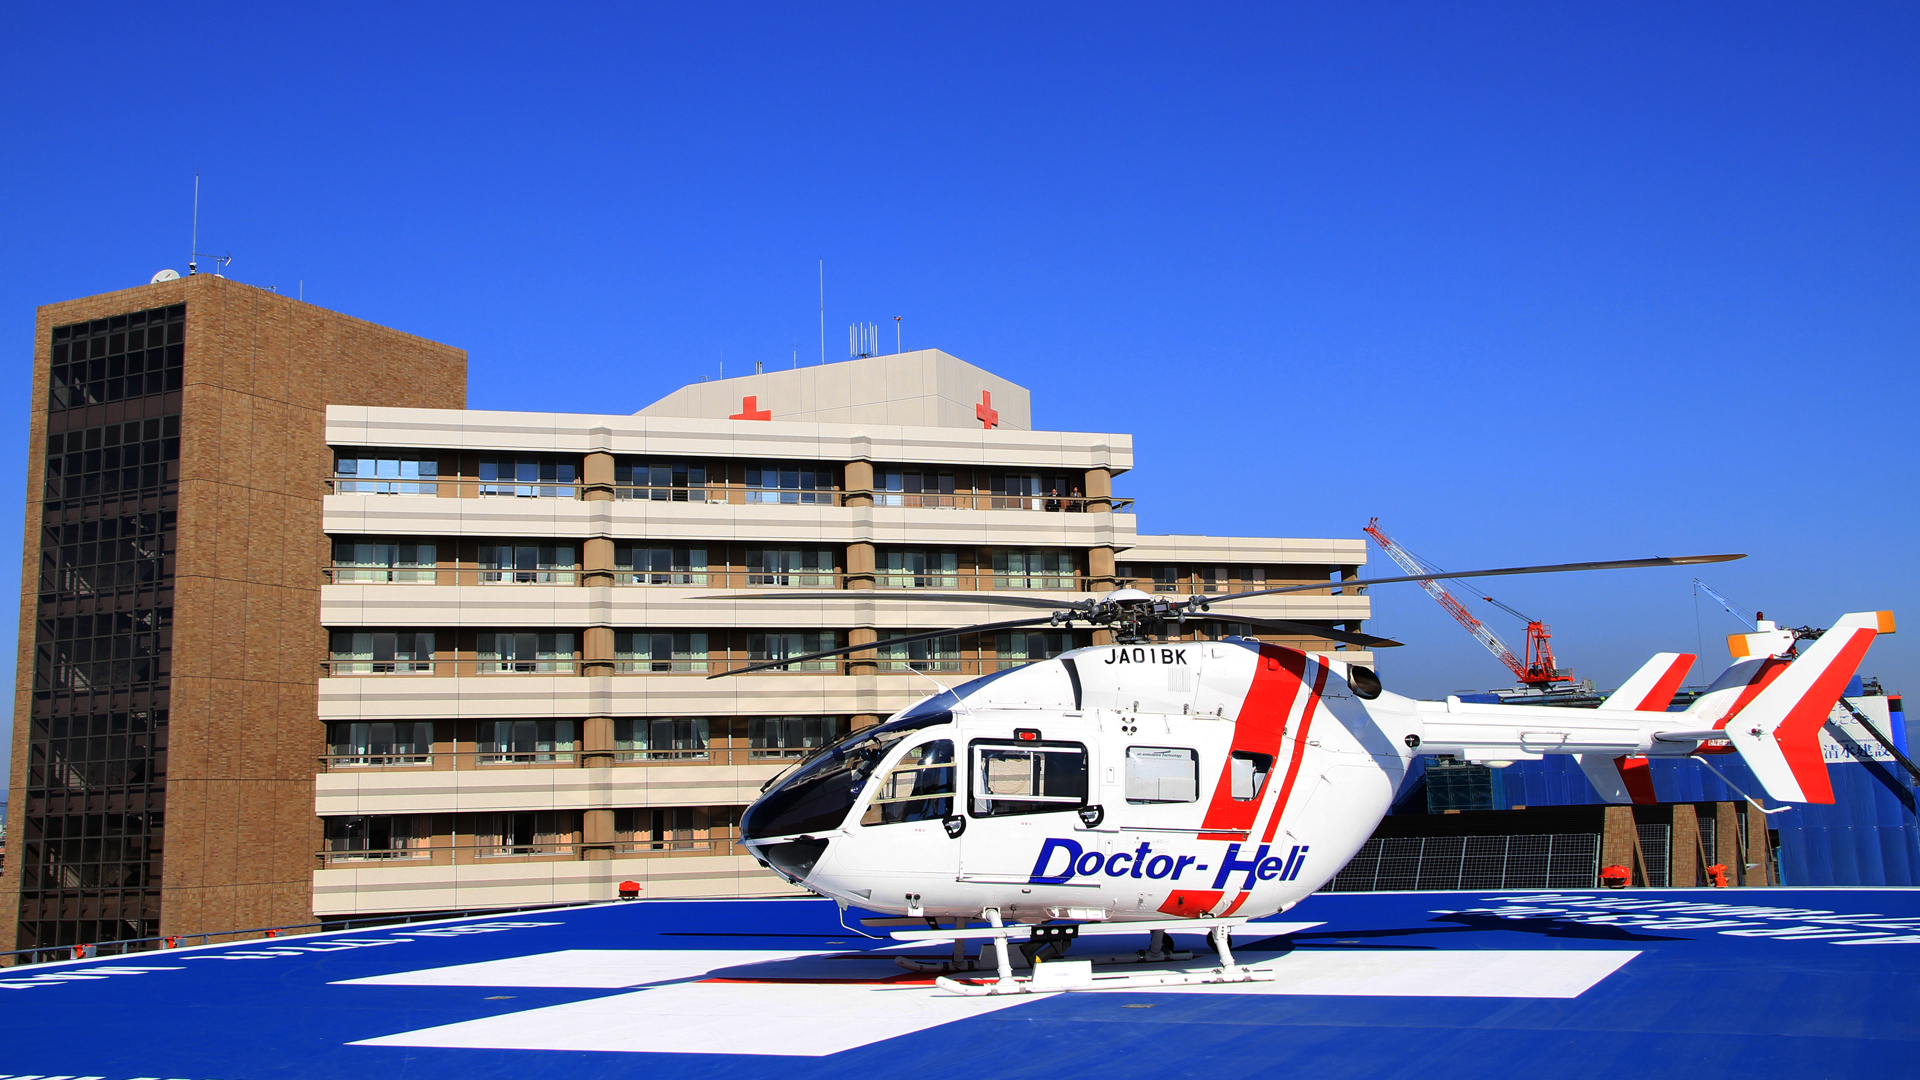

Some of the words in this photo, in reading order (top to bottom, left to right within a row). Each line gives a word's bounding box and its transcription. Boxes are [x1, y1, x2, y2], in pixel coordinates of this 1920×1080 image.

[1104, 648, 1187, 665] JA01BK
[1823, 743, 1890, 759] 清水建設
